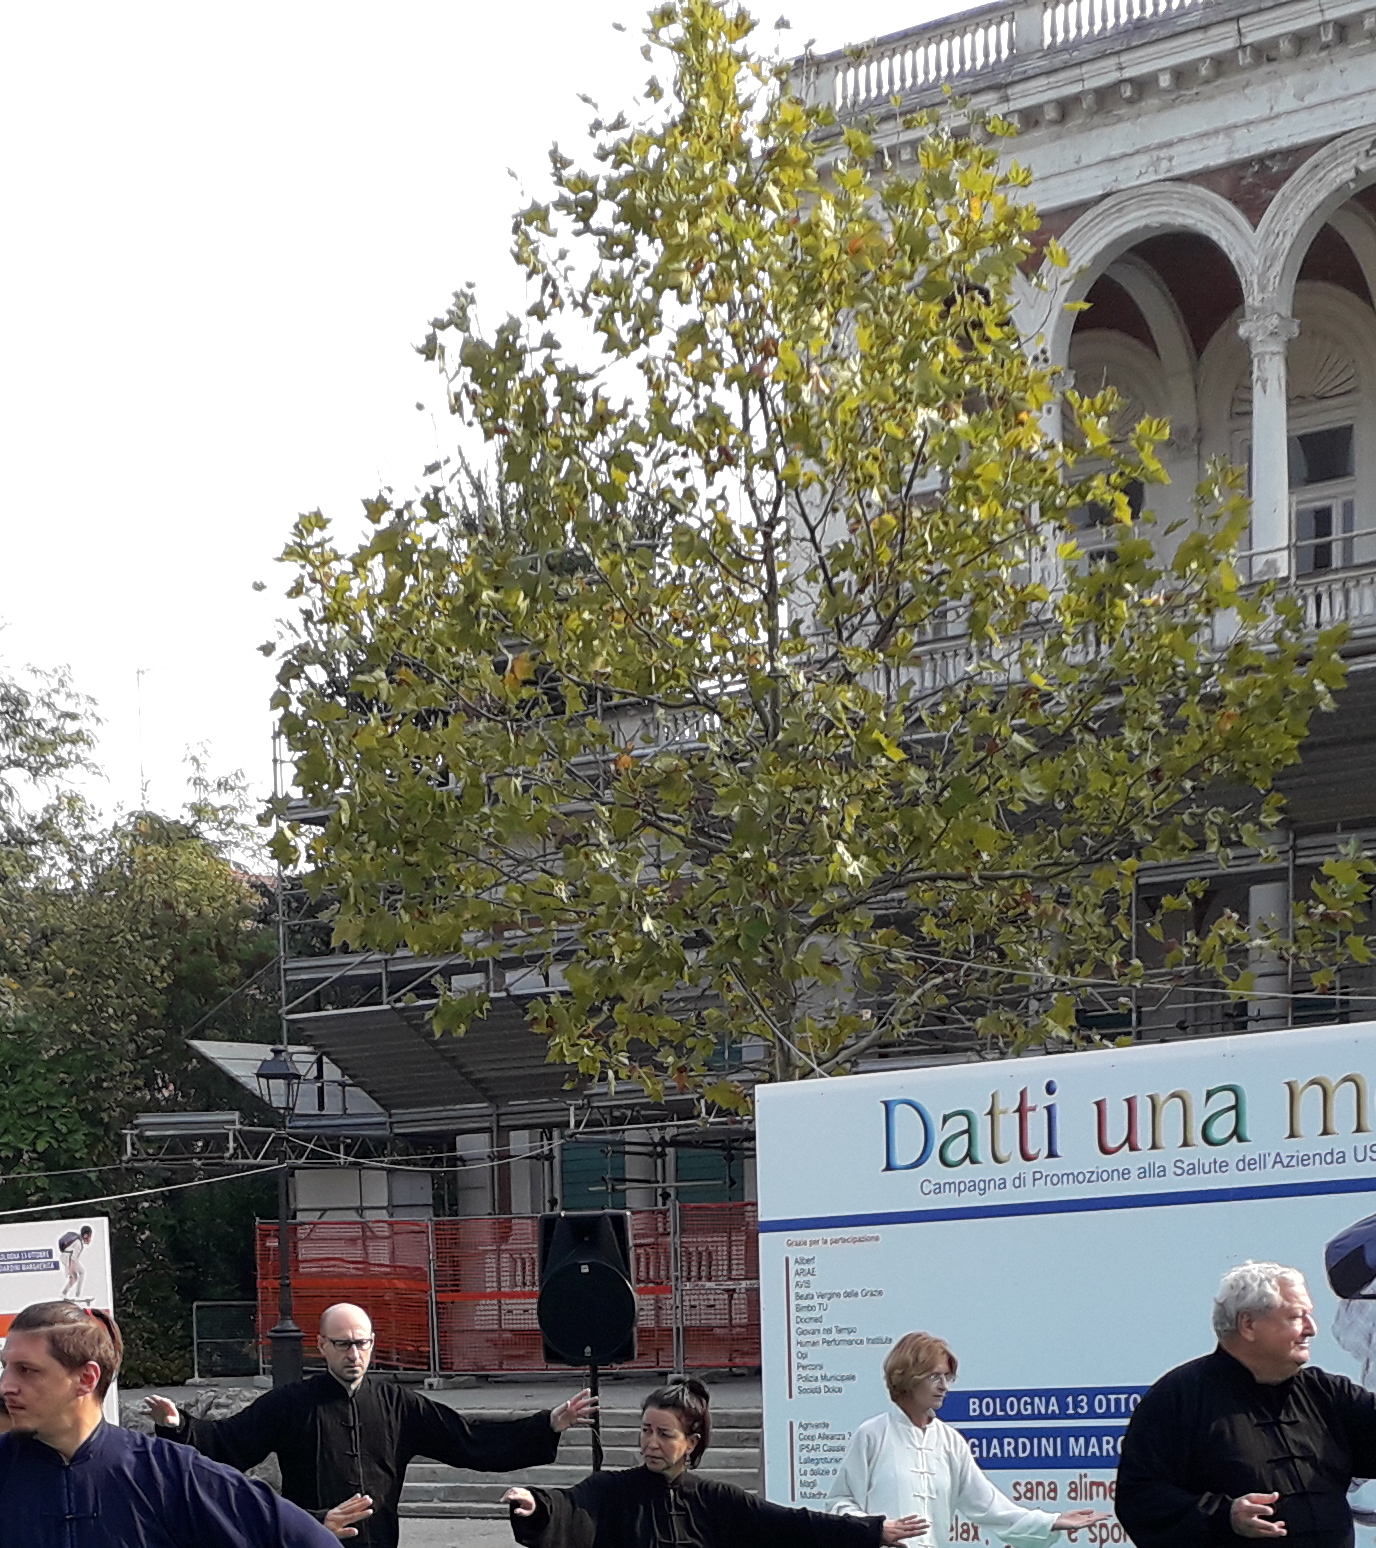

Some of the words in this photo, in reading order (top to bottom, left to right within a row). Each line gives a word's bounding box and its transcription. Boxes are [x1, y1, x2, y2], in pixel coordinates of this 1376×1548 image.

[880, 1079, 1063, 1173] Datti
[1092, 1083, 1253, 1157] una
[919, 1176, 1008, 1198] Campagna
[1012, 1171, 1027, 1190] di
[1032, 1167, 1132, 1188] Promozione
[1137, 1161, 1168, 1180] alla
[1173, 1156, 1230, 1178] Salute
[1235, 1148, 1347, 1174] dell'Azienda
[809, 1238, 820, 1247] per
[968, 1395, 1060, 1417] BOLOGNA
[1065, 1394, 1088, 1414] 13
[968, 1437, 1062, 1459] GIARDINI
[1012, 1480, 1058, 1502] sana
